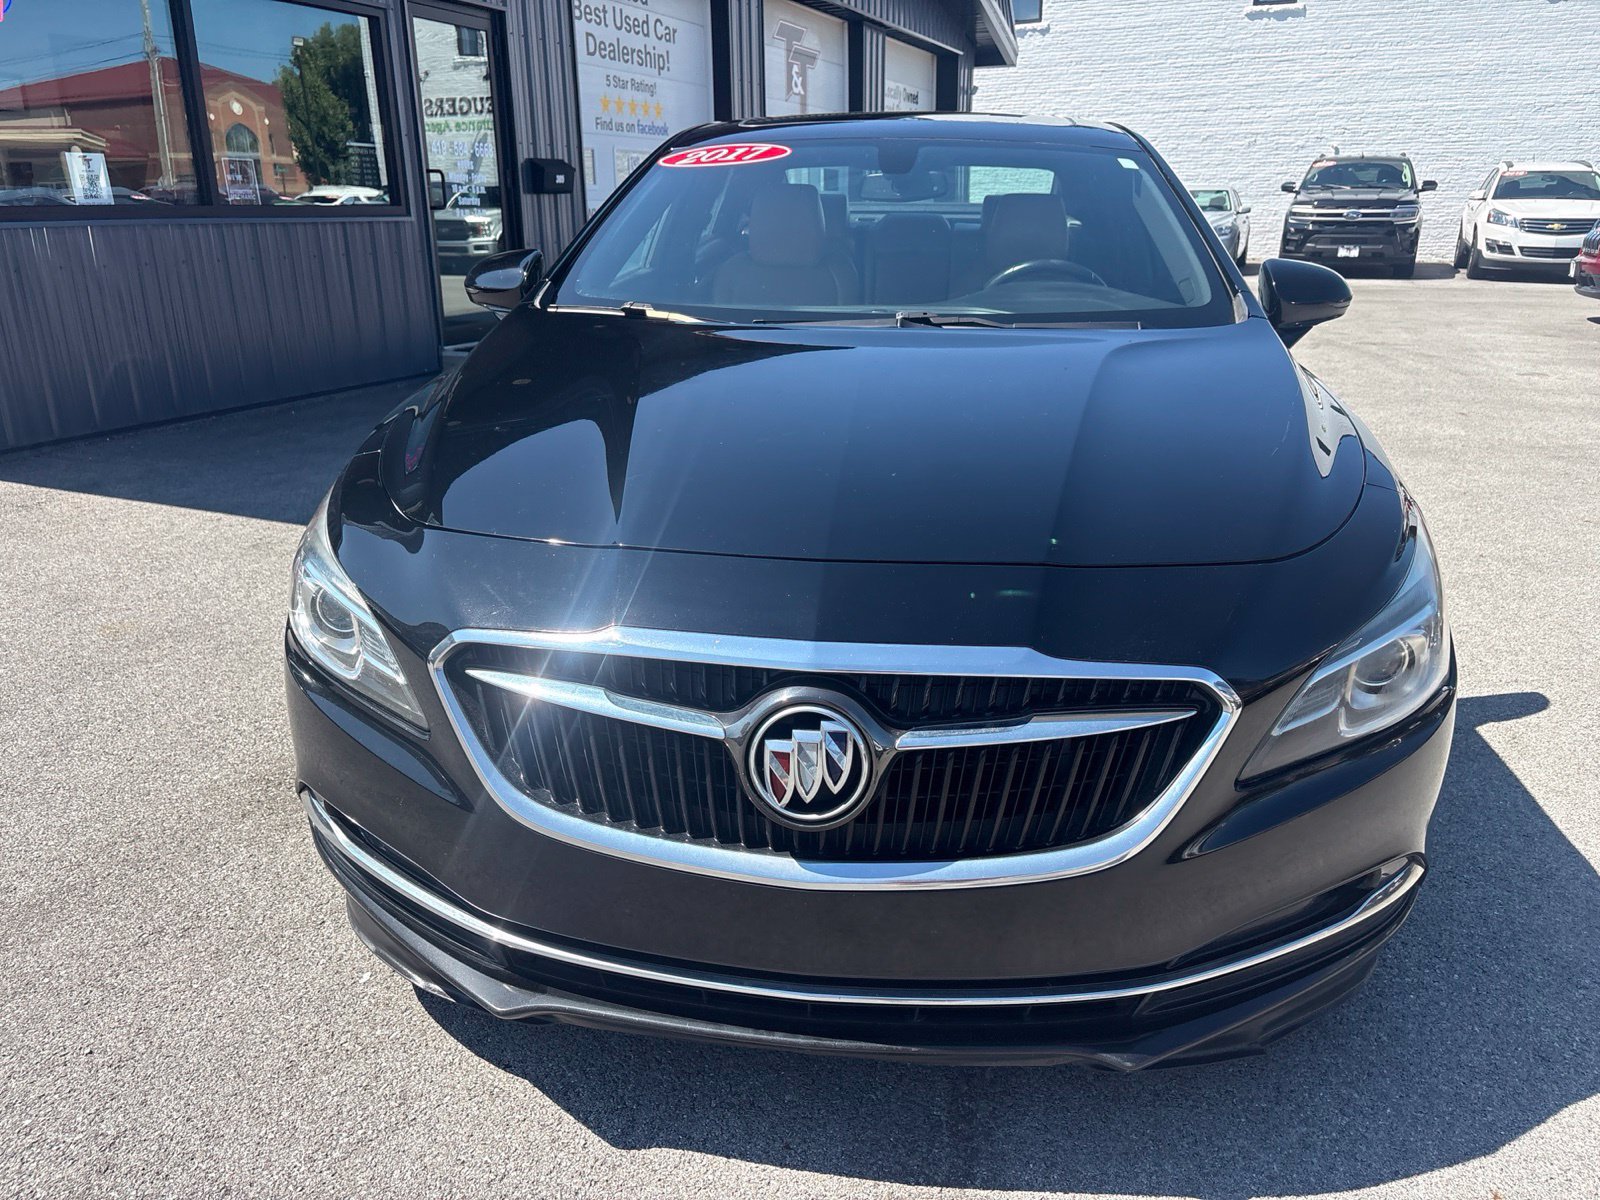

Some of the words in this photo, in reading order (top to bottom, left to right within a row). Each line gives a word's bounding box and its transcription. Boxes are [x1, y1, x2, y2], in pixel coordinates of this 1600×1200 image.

[574, 0, 609, 28] Best
[612, 6, 650, 38] Used
[653, 18, 678, 45] Car
[585, 31, 670, 76] Dealership!
[605, 74, 611, 87] 5
[612, 75, 629, 90] Star
[630, 78, 657, 97] Rating!
[594, 116, 613, 131] Find
[614, 121, 624, 133] us
[625, 123, 636, 133] on
[636, 118, 669, 136] facebook
[674, 146, 773, 165] 2017
